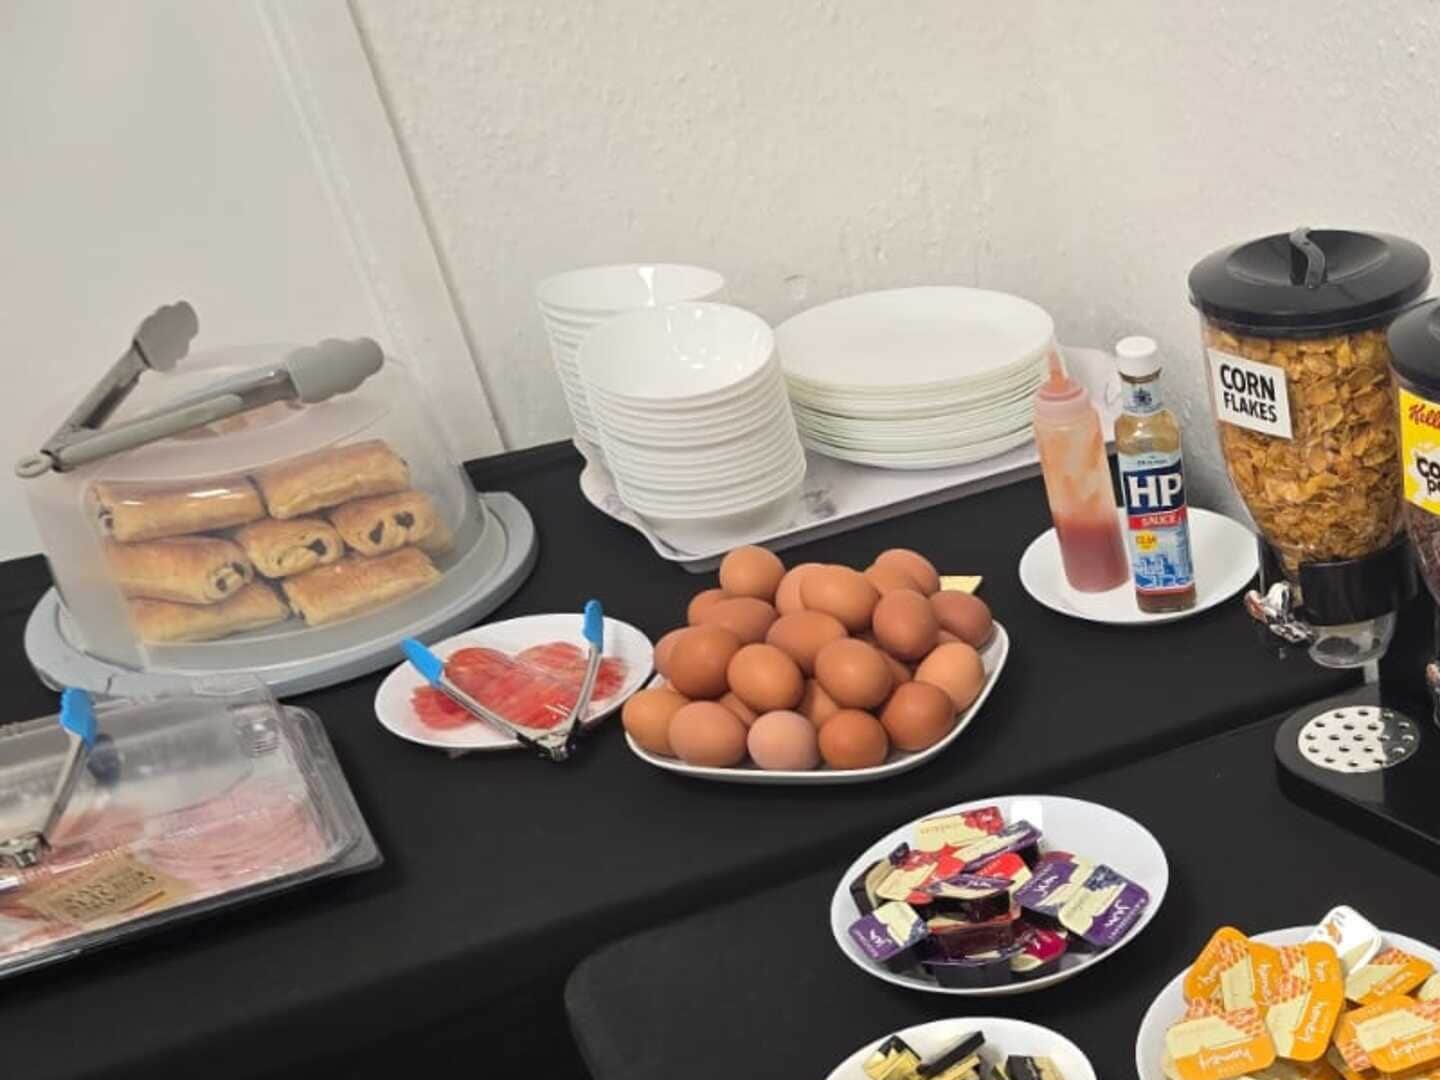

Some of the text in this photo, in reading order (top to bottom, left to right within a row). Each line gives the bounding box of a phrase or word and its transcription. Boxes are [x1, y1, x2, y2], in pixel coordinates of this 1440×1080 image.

[1220, 364, 1276, 402] CORN
[1223, 391, 1277, 423] FLAKES
[1128, 472, 1182, 508] HP
